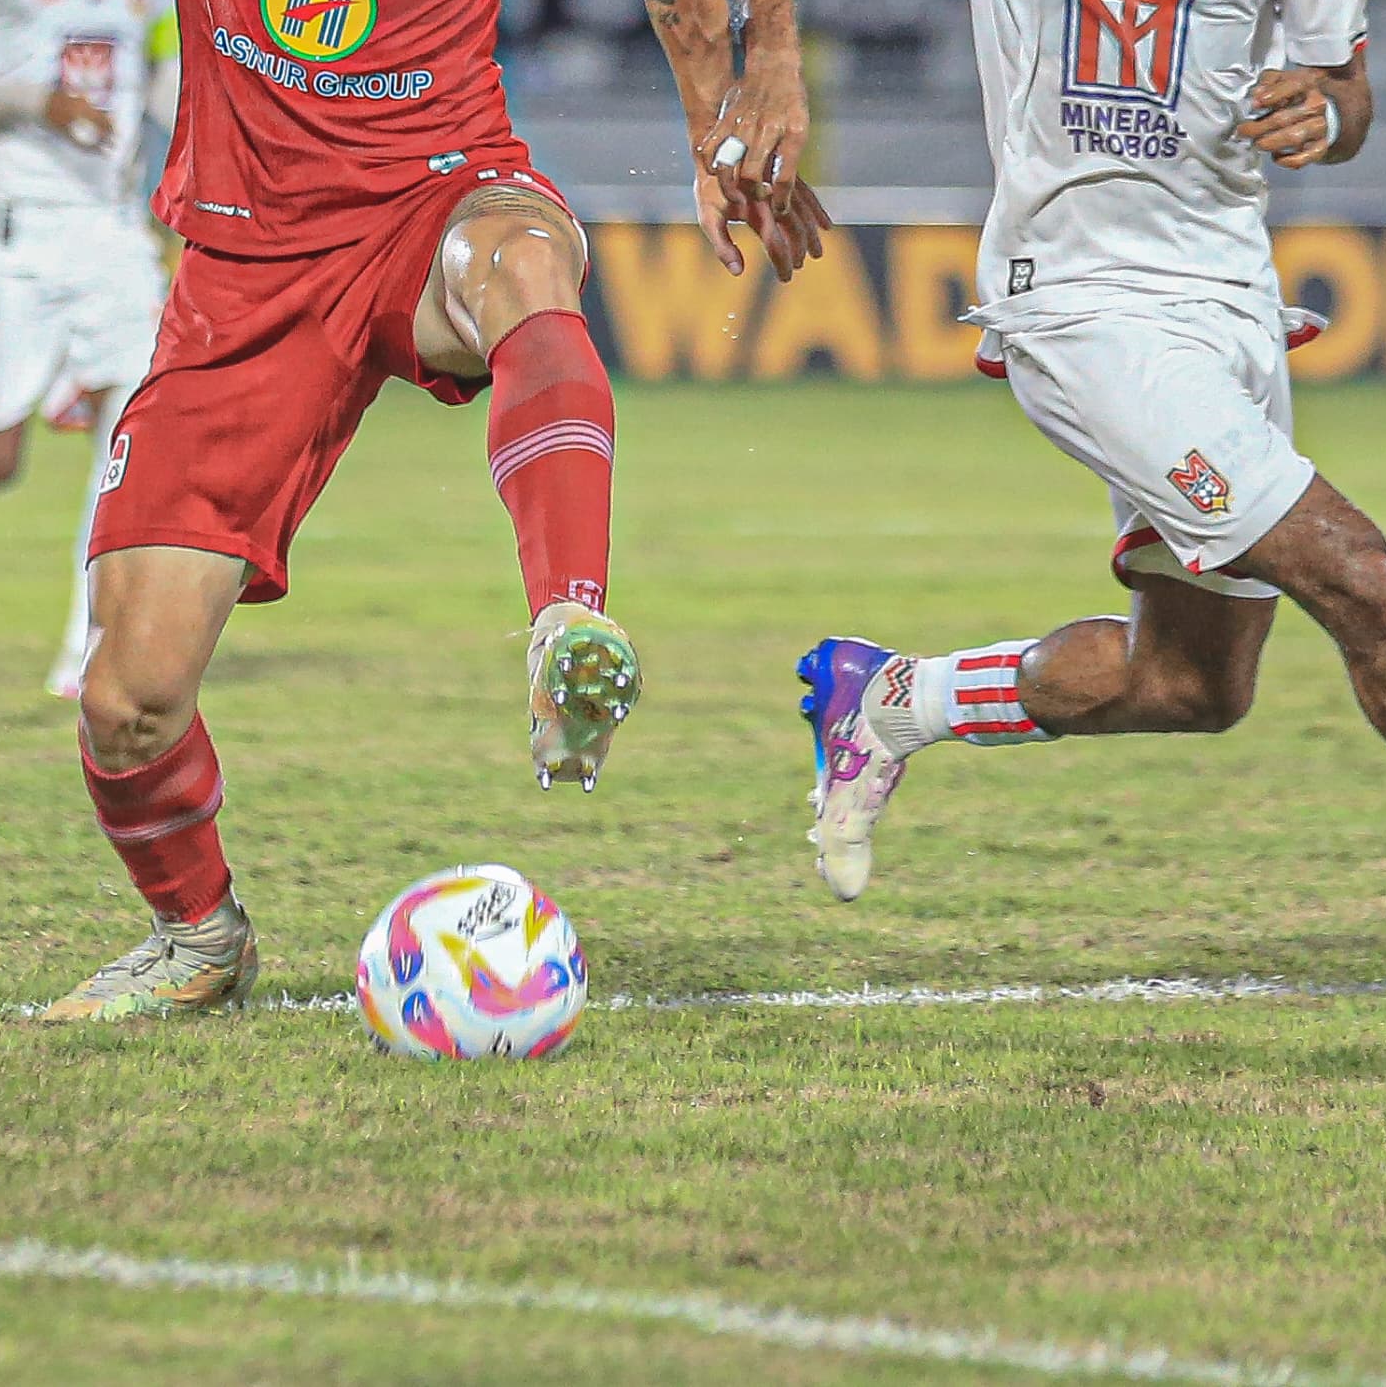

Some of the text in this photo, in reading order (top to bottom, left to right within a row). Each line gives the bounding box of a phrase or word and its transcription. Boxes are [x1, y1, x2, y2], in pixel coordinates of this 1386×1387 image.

[313, 70, 433, 100] GROUP
[1062, 103, 1188, 139] MINERAL
[1067, 128, 1180, 158] TROBOS
